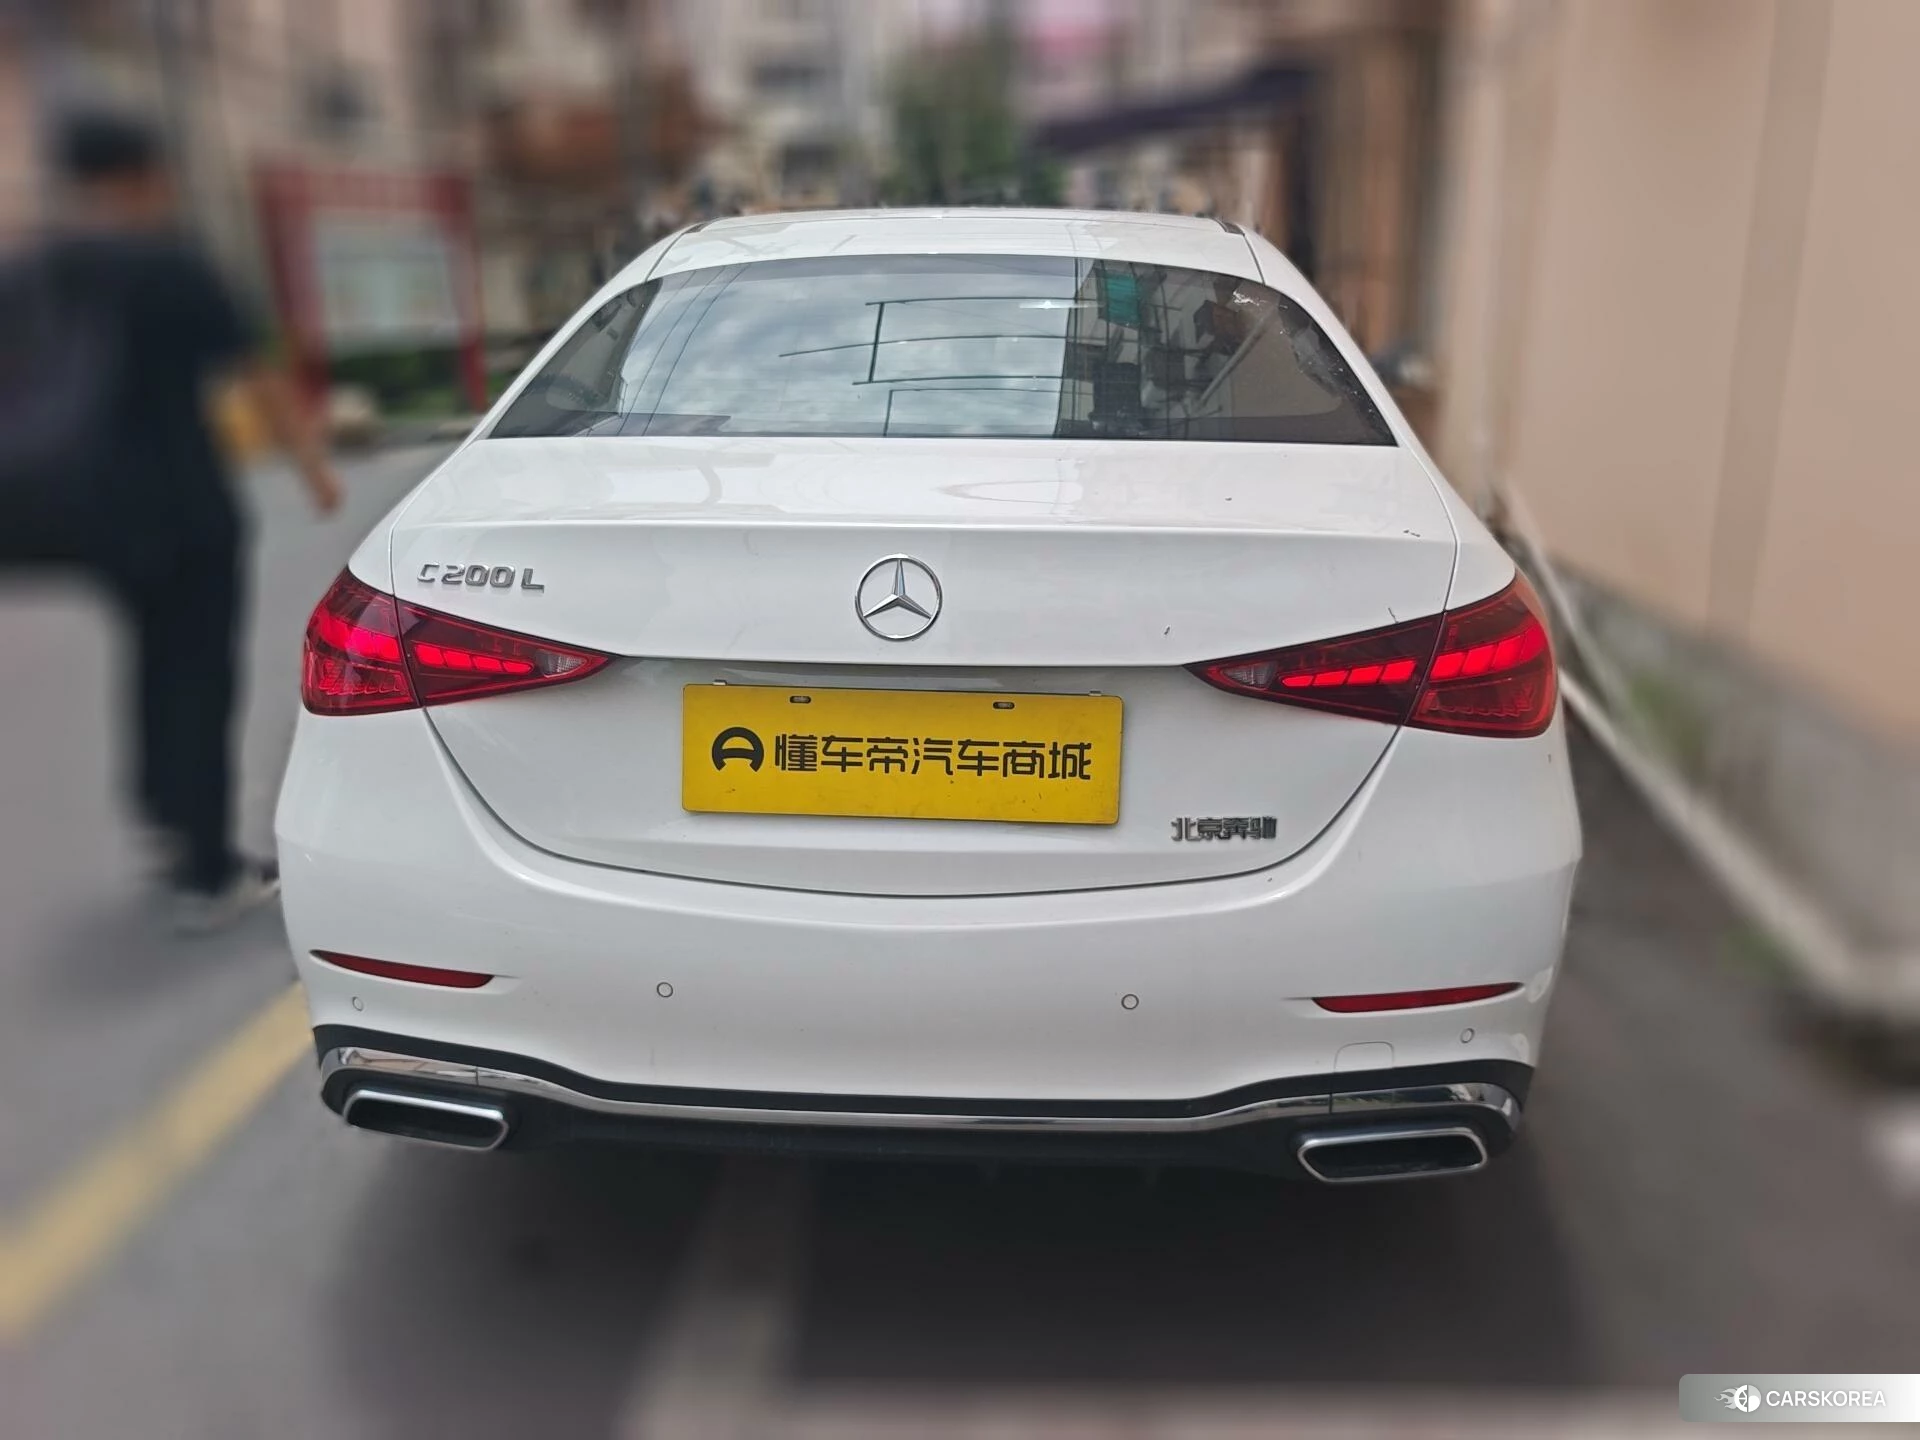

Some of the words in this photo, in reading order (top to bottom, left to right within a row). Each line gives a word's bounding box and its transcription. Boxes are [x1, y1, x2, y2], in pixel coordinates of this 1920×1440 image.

[774, 733, 1092, 781] 懂车帝汽车商城
